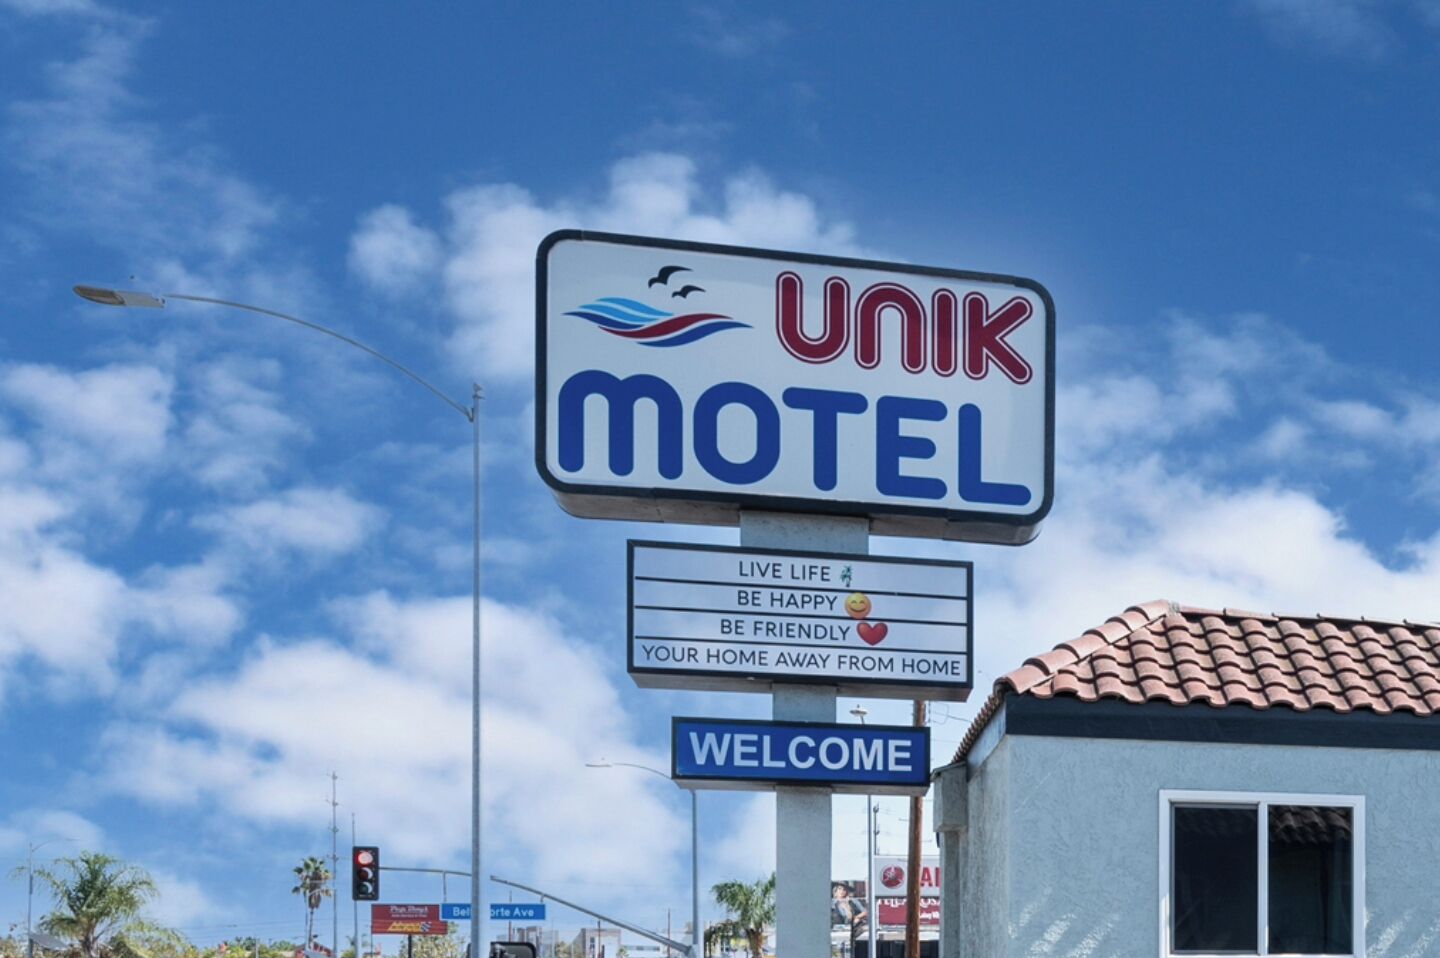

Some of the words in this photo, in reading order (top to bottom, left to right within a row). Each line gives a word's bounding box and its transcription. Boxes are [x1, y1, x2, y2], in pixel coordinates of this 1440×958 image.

[776, 271, 1033, 385] UNIK
[558, 369, 1031, 506] MOTEL
[739, 560, 782, 579] LIVE
[791, 563, 831, 582] LIFE
[737, 590, 761, 607] BE
[770, 592, 838, 611] HAPPY
[721, 619, 745, 635] BE
[753, 620, 851, 641] FRIENDLY
[642, 644, 699, 663] YOUR
[706, 647, 769, 667] HOME
[775, 651, 831, 670] AWAY
[838, 654, 894, 673] FROM
[902, 658, 961, 676] HOME
[689, 732, 913, 772] WELCOME
[513, 907, 534, 917] Ave
